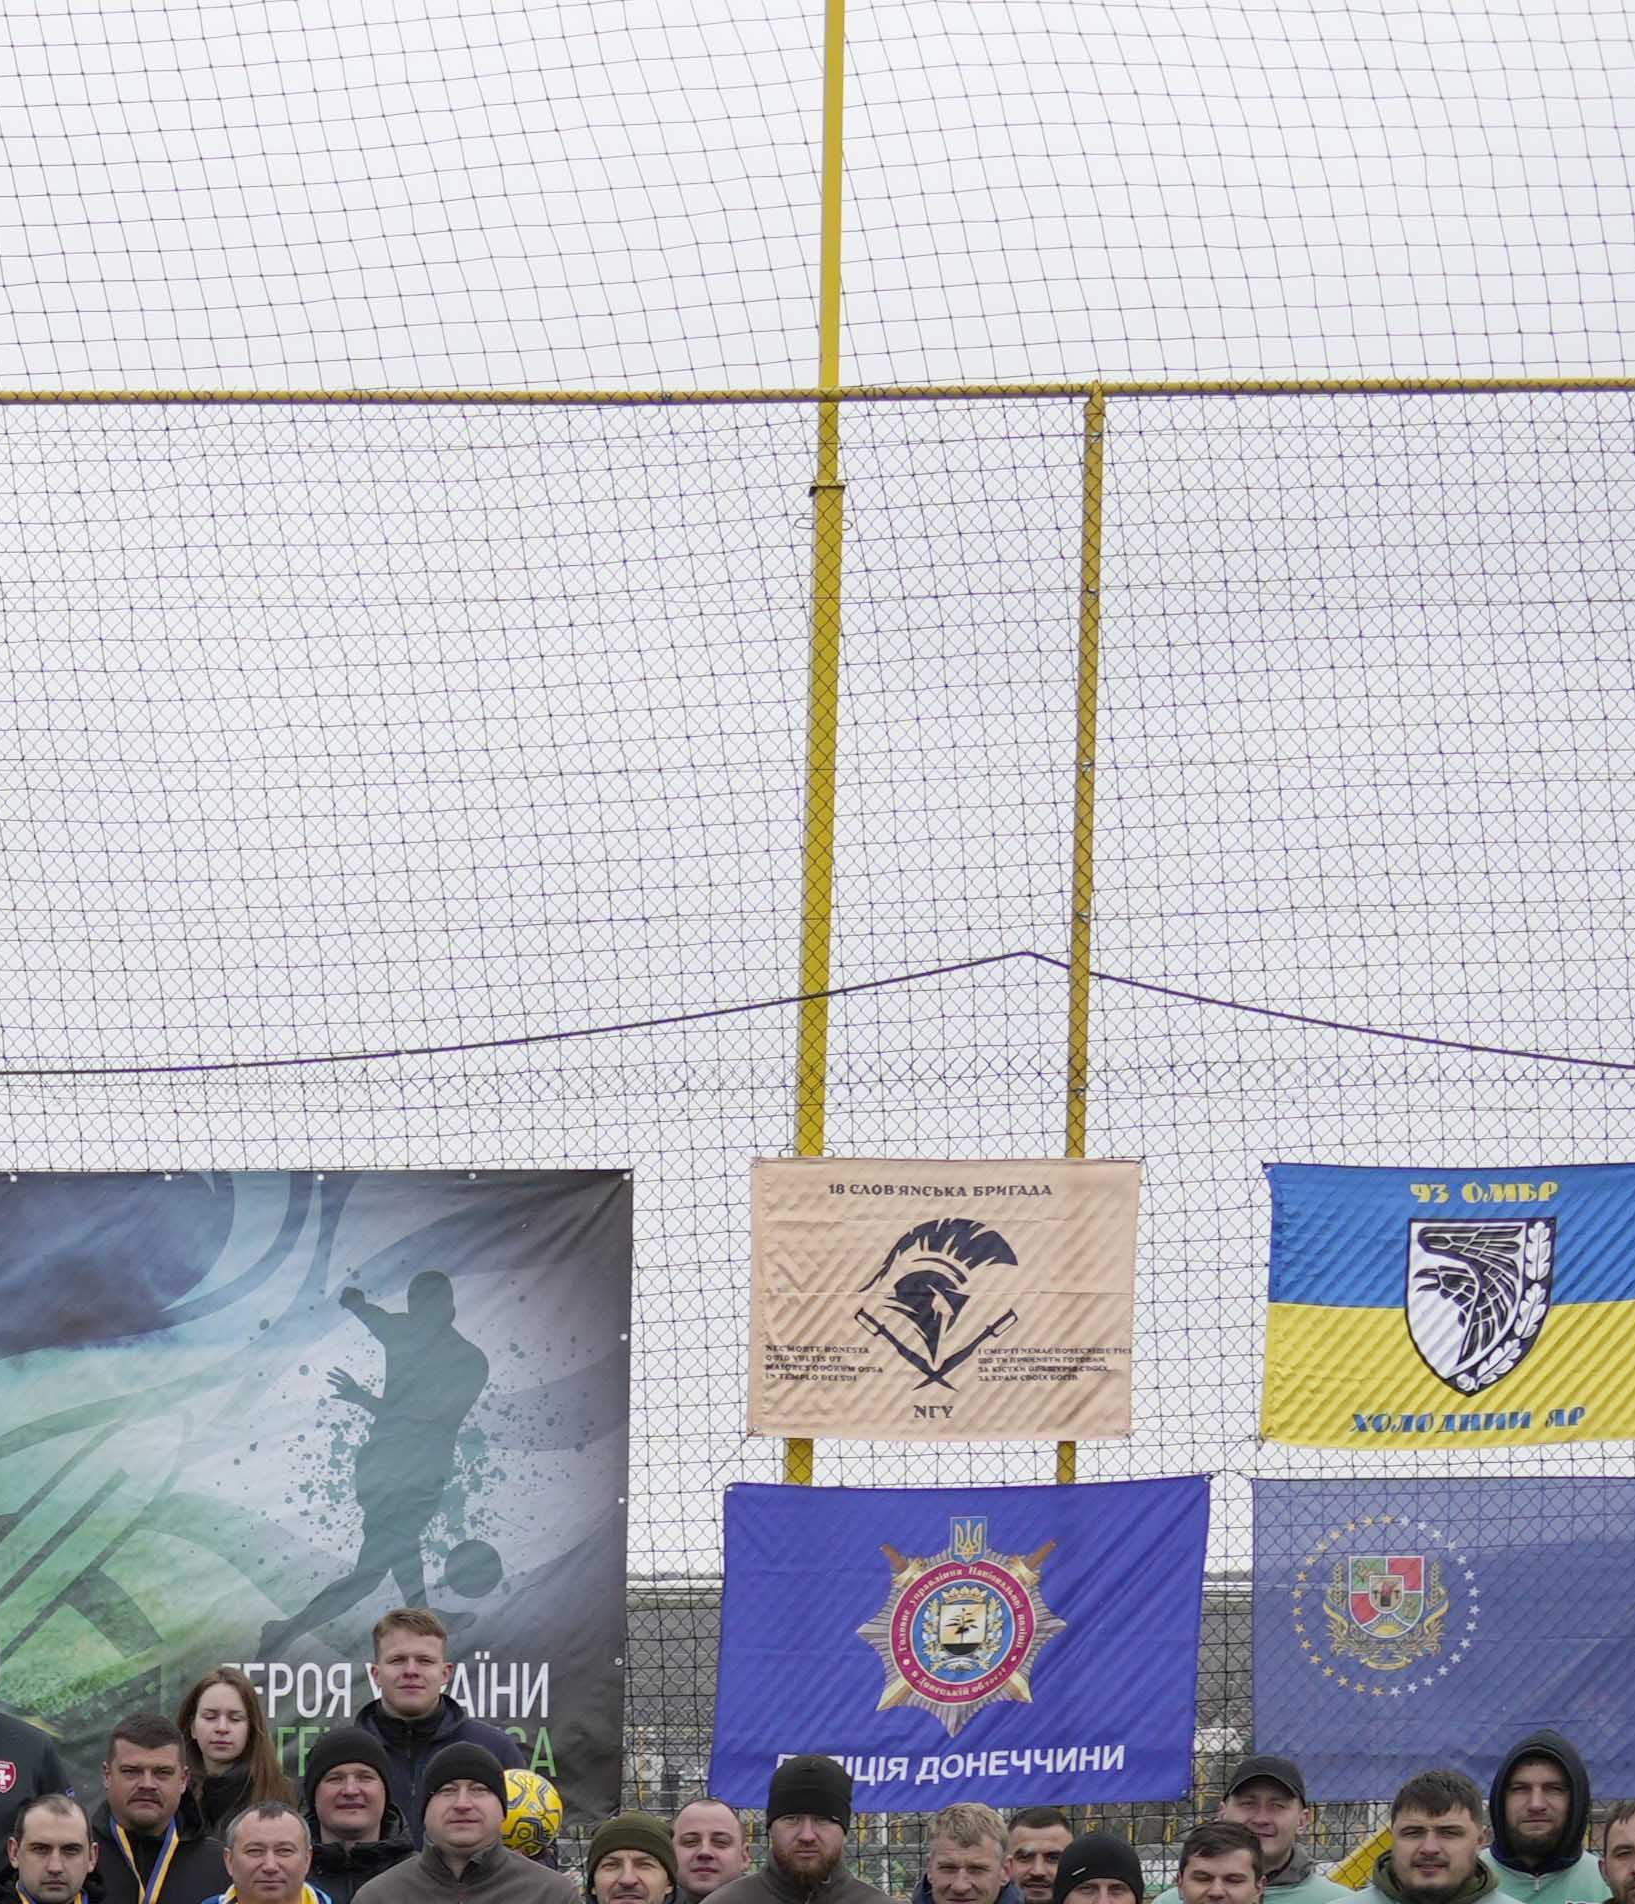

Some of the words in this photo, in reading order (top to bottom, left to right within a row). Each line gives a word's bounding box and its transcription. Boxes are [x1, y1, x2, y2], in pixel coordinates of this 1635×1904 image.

[828, 1184, 845, 1195] 18
[973, 1184, 1053, 1197] БРИГАДА
[1410, 1183, 1450, 1203] 93
[1461, 1182, 1558, 1203] ОМБР
[1350, 1409, 1532, 1434] ХОЛОДНИЙ
[1545, 1406, 1586, 1428] ЯР
[221, 1662, 352, 1718] ЕРОЯ
[916, 1745, 1125, 1785] ДОНЕЧЧИНИ
